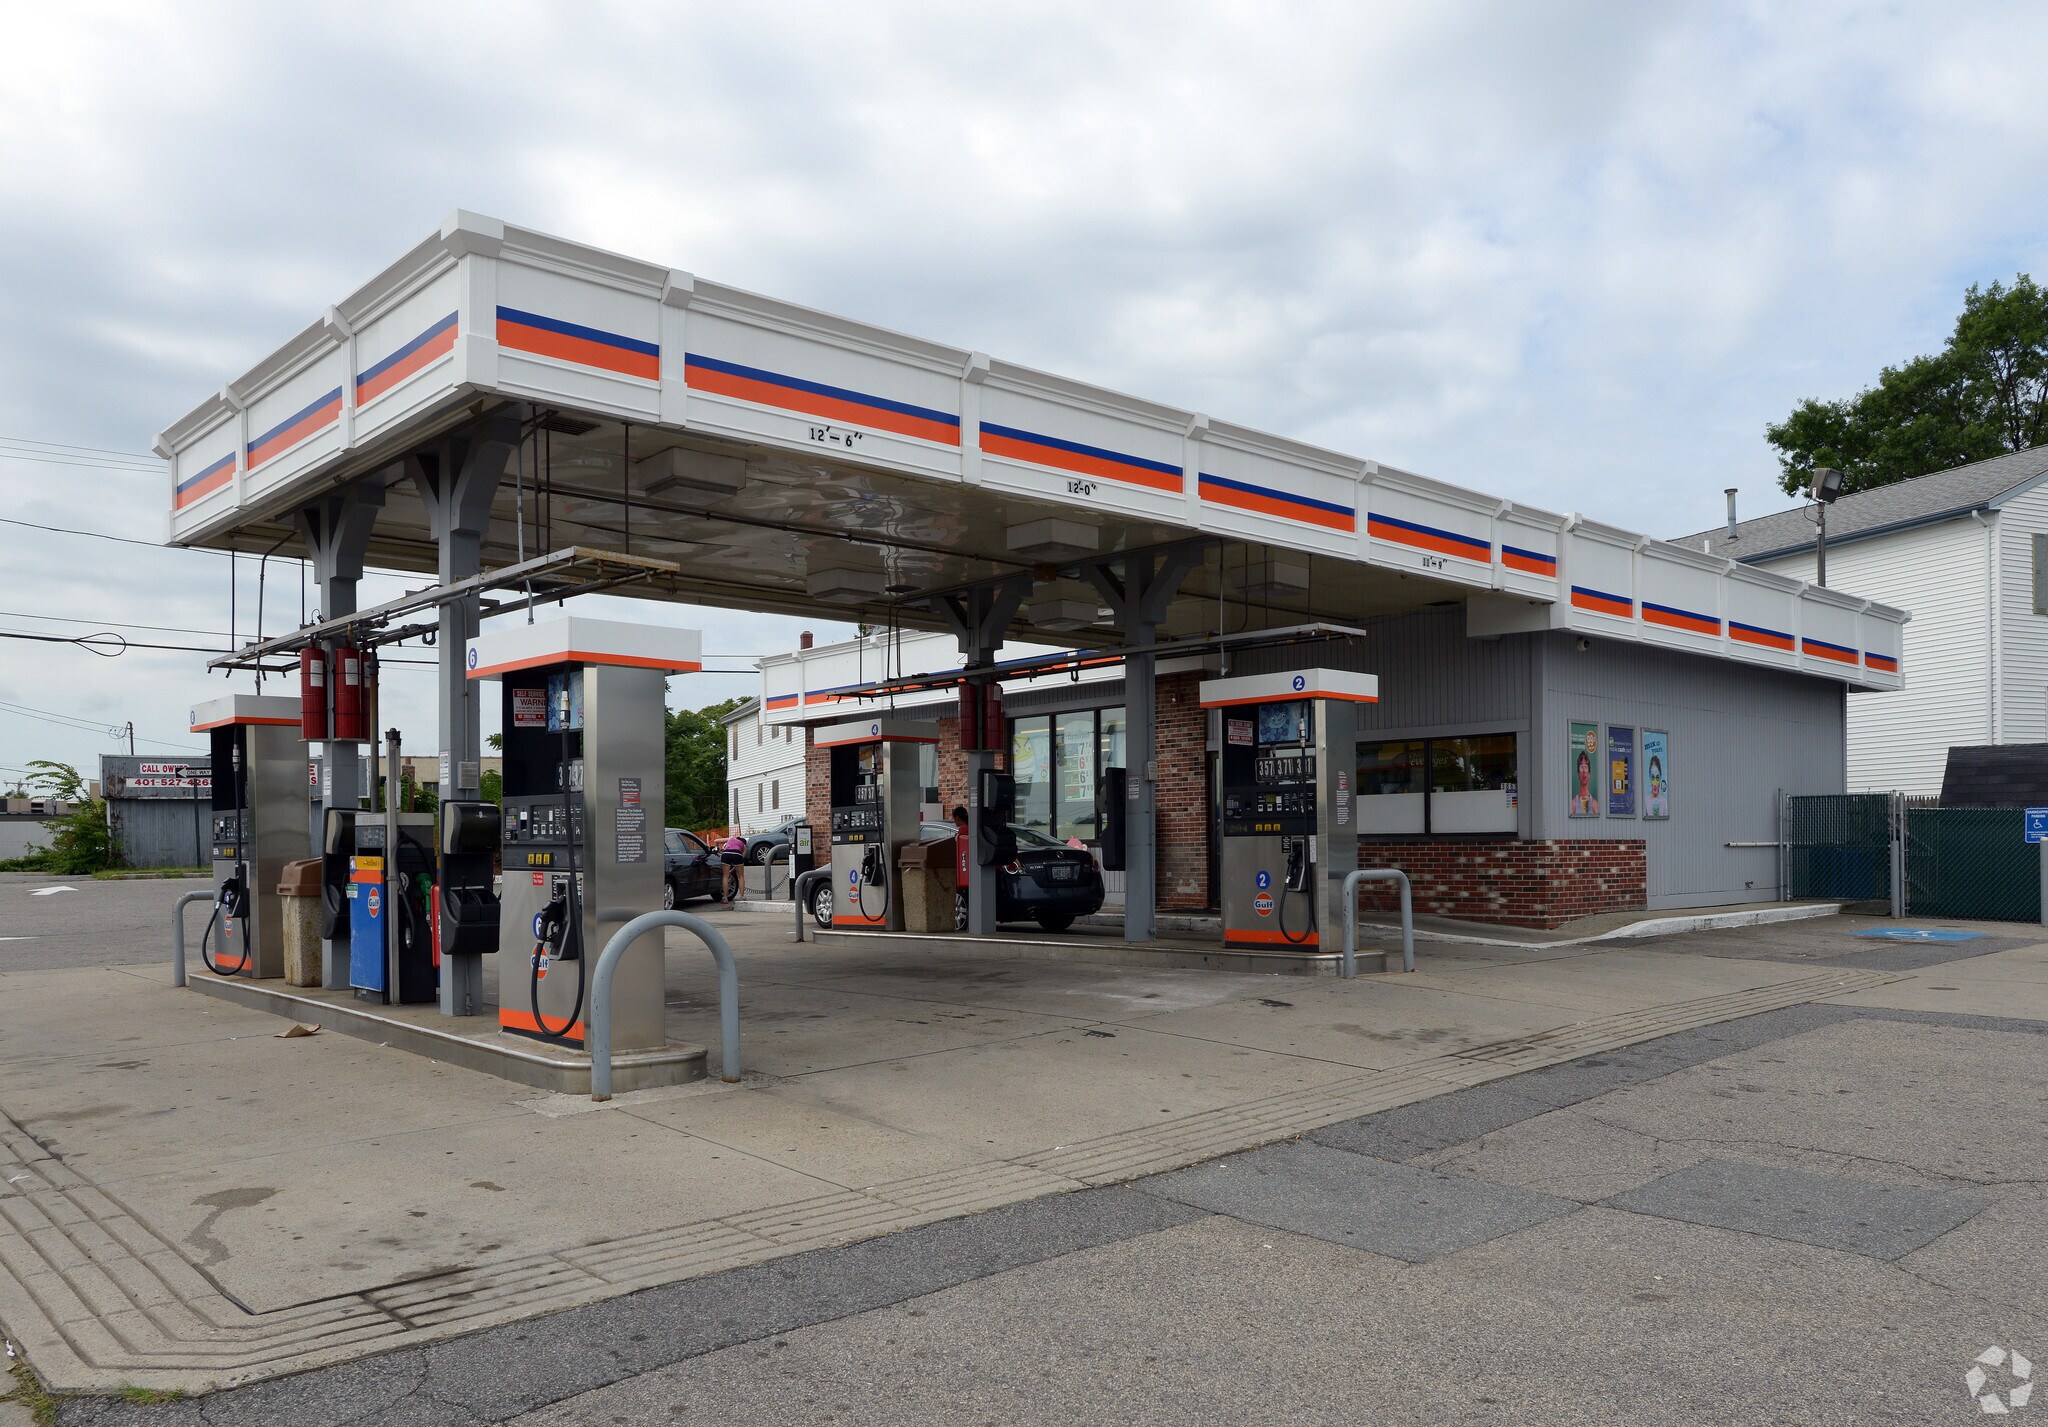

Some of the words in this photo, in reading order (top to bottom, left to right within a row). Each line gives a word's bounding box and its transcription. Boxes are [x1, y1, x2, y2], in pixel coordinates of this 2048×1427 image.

[1296, 677, 1303, 689] 2
[519, 698, 546, 706] WARNI
[141, 764, 160, 773] CALL
[134, 778, 213, 786] 401-527-426
[799, 838, 809, 847] air
[1259, 873, 1267, 887] 2
[1254, 900, 1274, 908] Gulf
